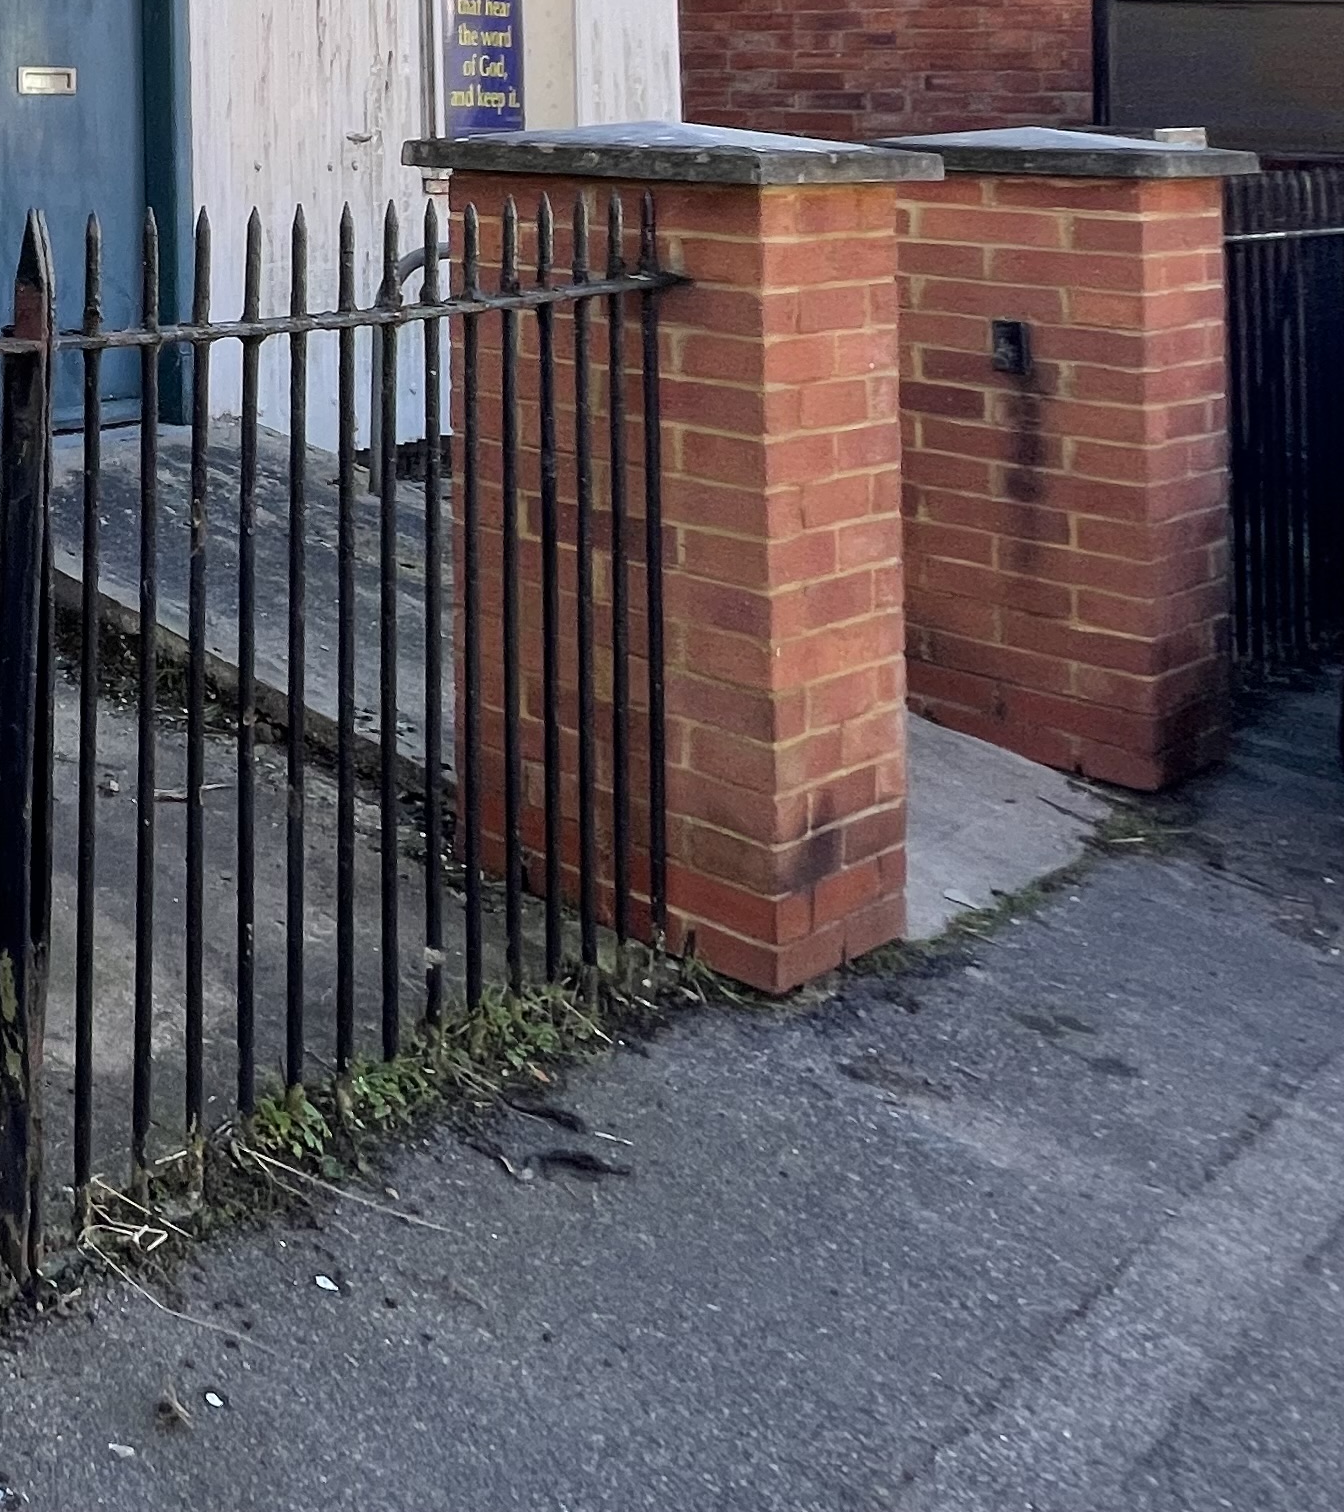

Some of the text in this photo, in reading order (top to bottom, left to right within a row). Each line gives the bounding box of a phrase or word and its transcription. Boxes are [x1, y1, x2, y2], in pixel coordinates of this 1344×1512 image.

[458, 22, 512, 48] the word
[462, 53, 508, 80] of God,
[450, 83, 521, 115] and keep it.
